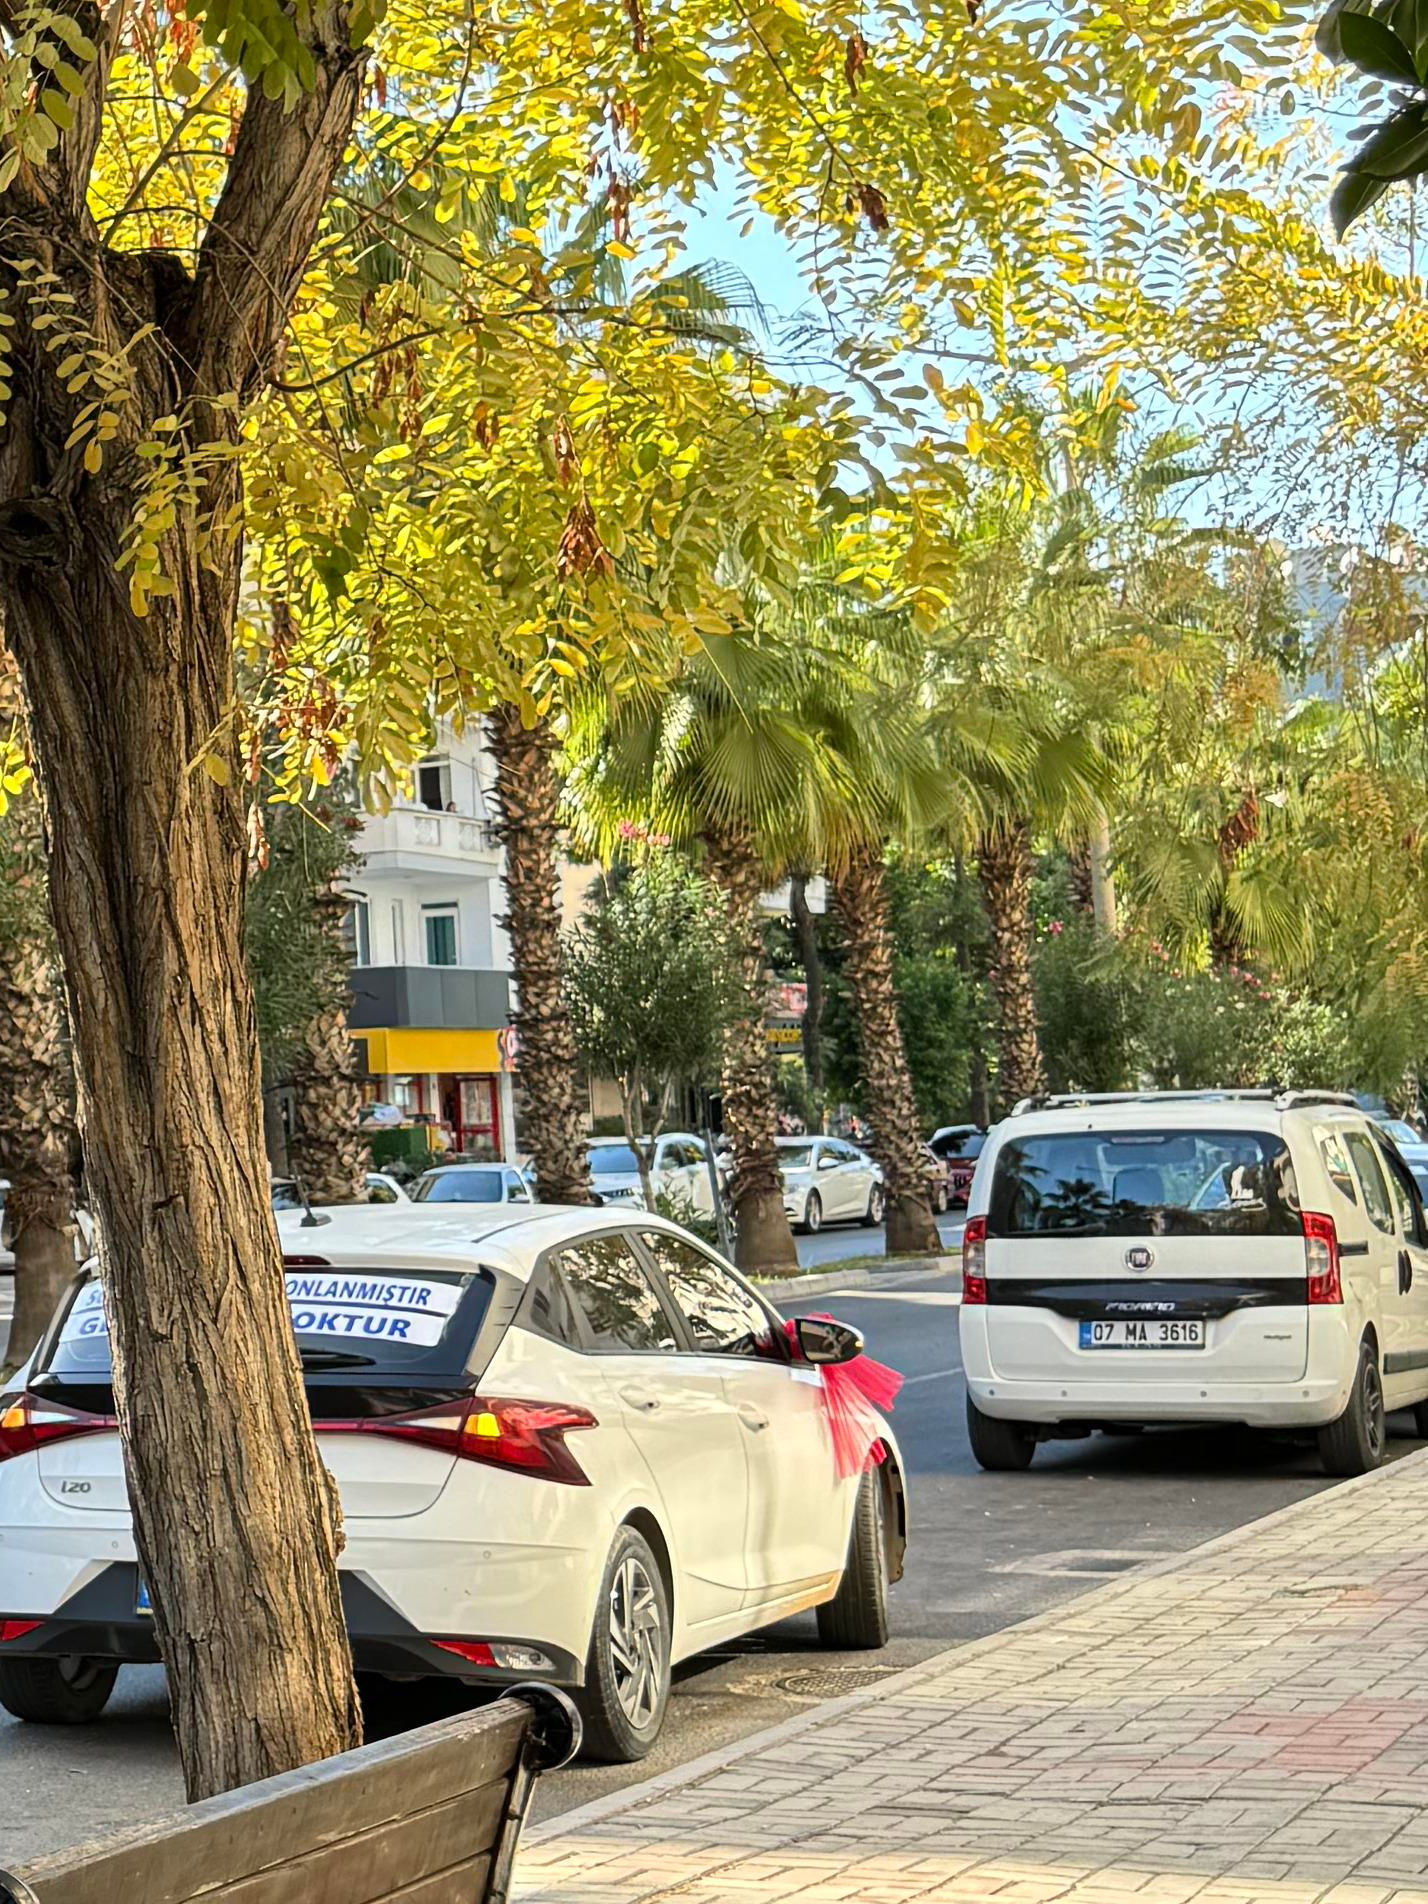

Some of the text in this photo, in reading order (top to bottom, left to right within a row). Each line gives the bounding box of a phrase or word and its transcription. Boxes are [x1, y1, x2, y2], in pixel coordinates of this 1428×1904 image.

[286, 1279, 432, 1307] ONLANMIŞTIR
[294, 1311, 411, 1338] OKTUR
[1093, 1323, 1199, 1342] 07 MA 3616
